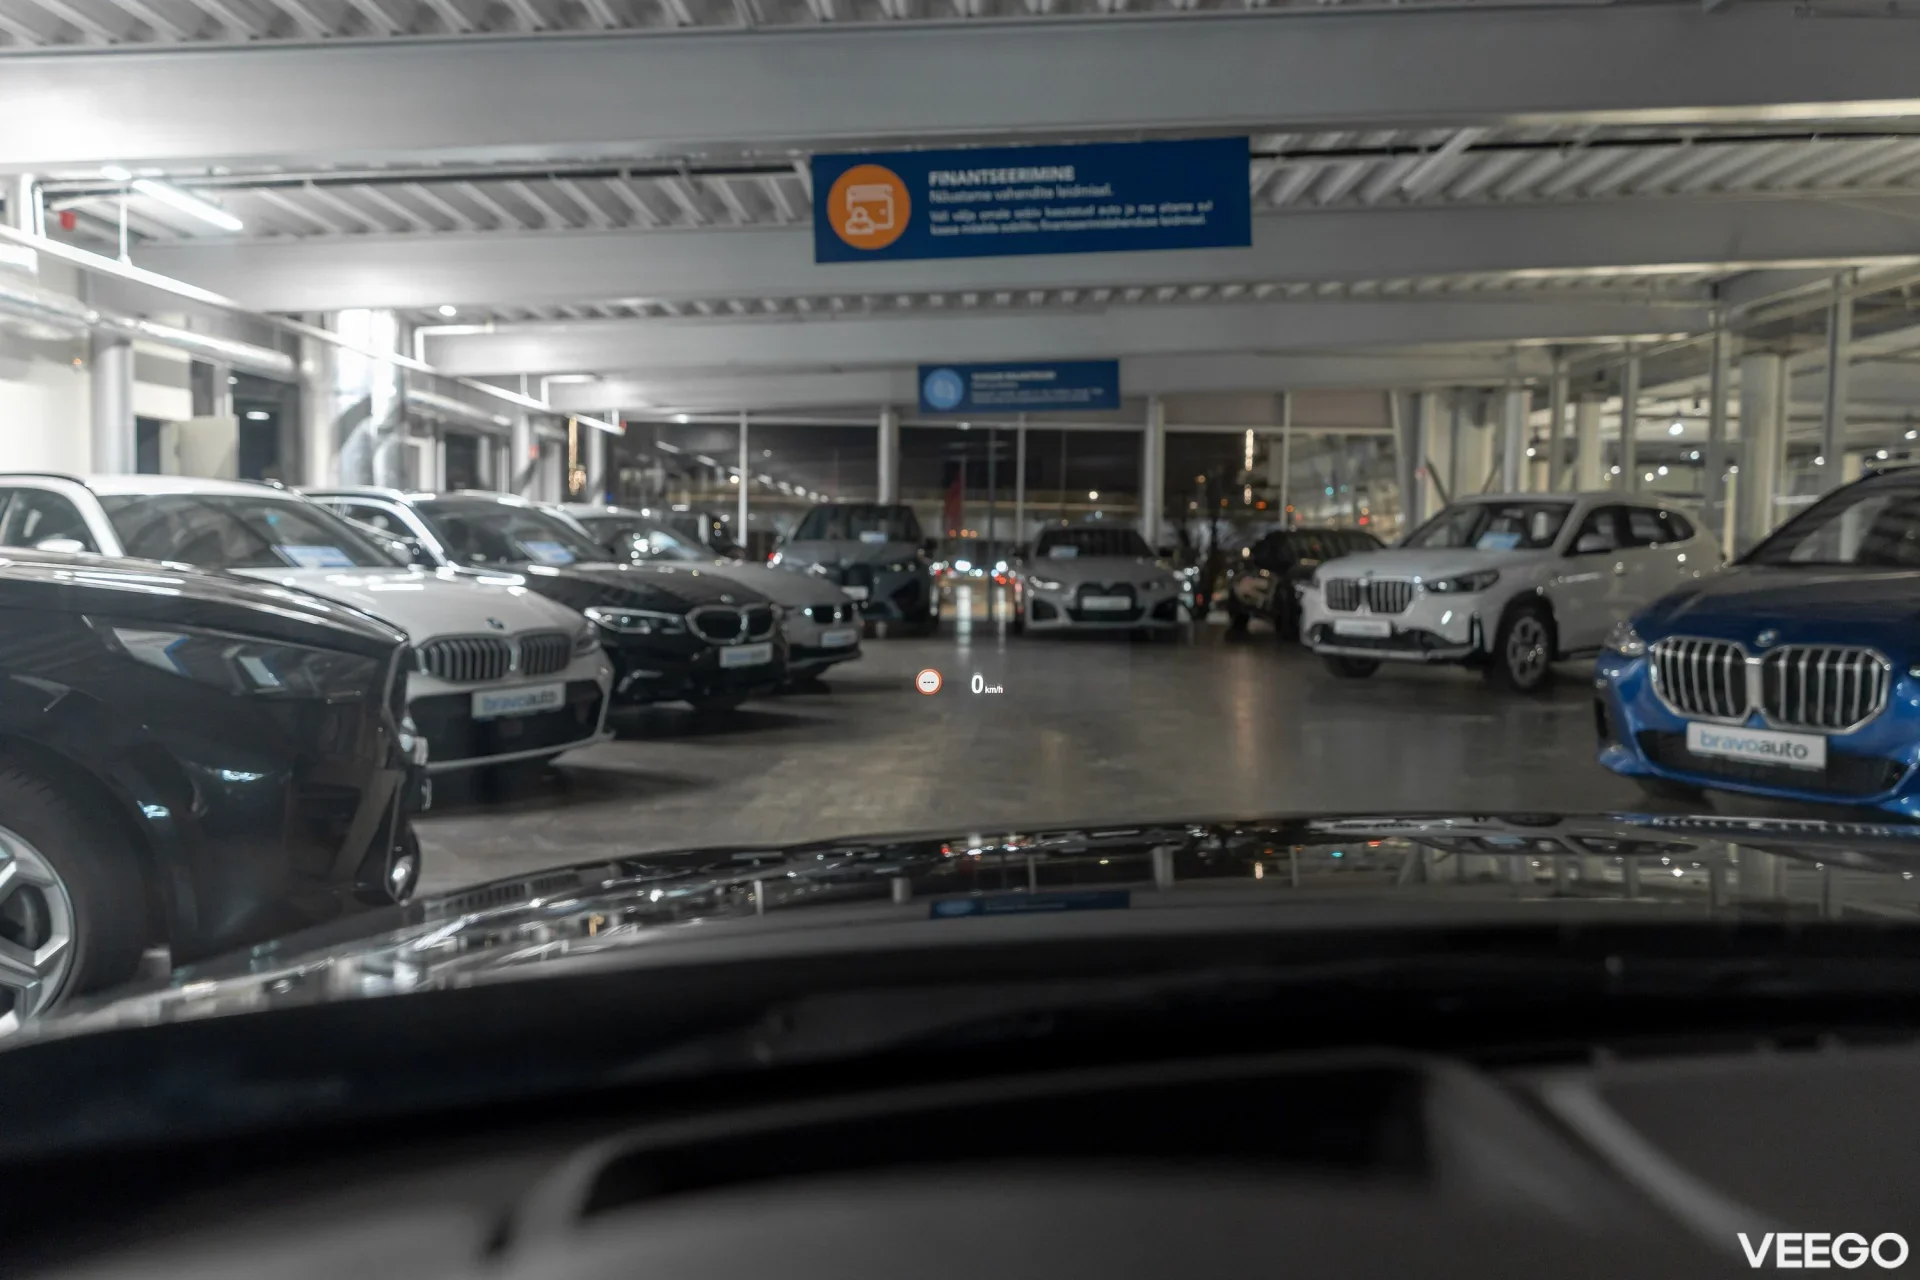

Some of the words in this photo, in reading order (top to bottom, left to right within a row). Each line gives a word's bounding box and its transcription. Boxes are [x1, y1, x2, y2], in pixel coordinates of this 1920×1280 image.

[928, 165, 1075, 187] FINANTSEERIMINE
[971, 673, 984, 694] 0
[985, 685, 1004, 694] km/h
[1700, 730, 1809, 760] bravoauto
